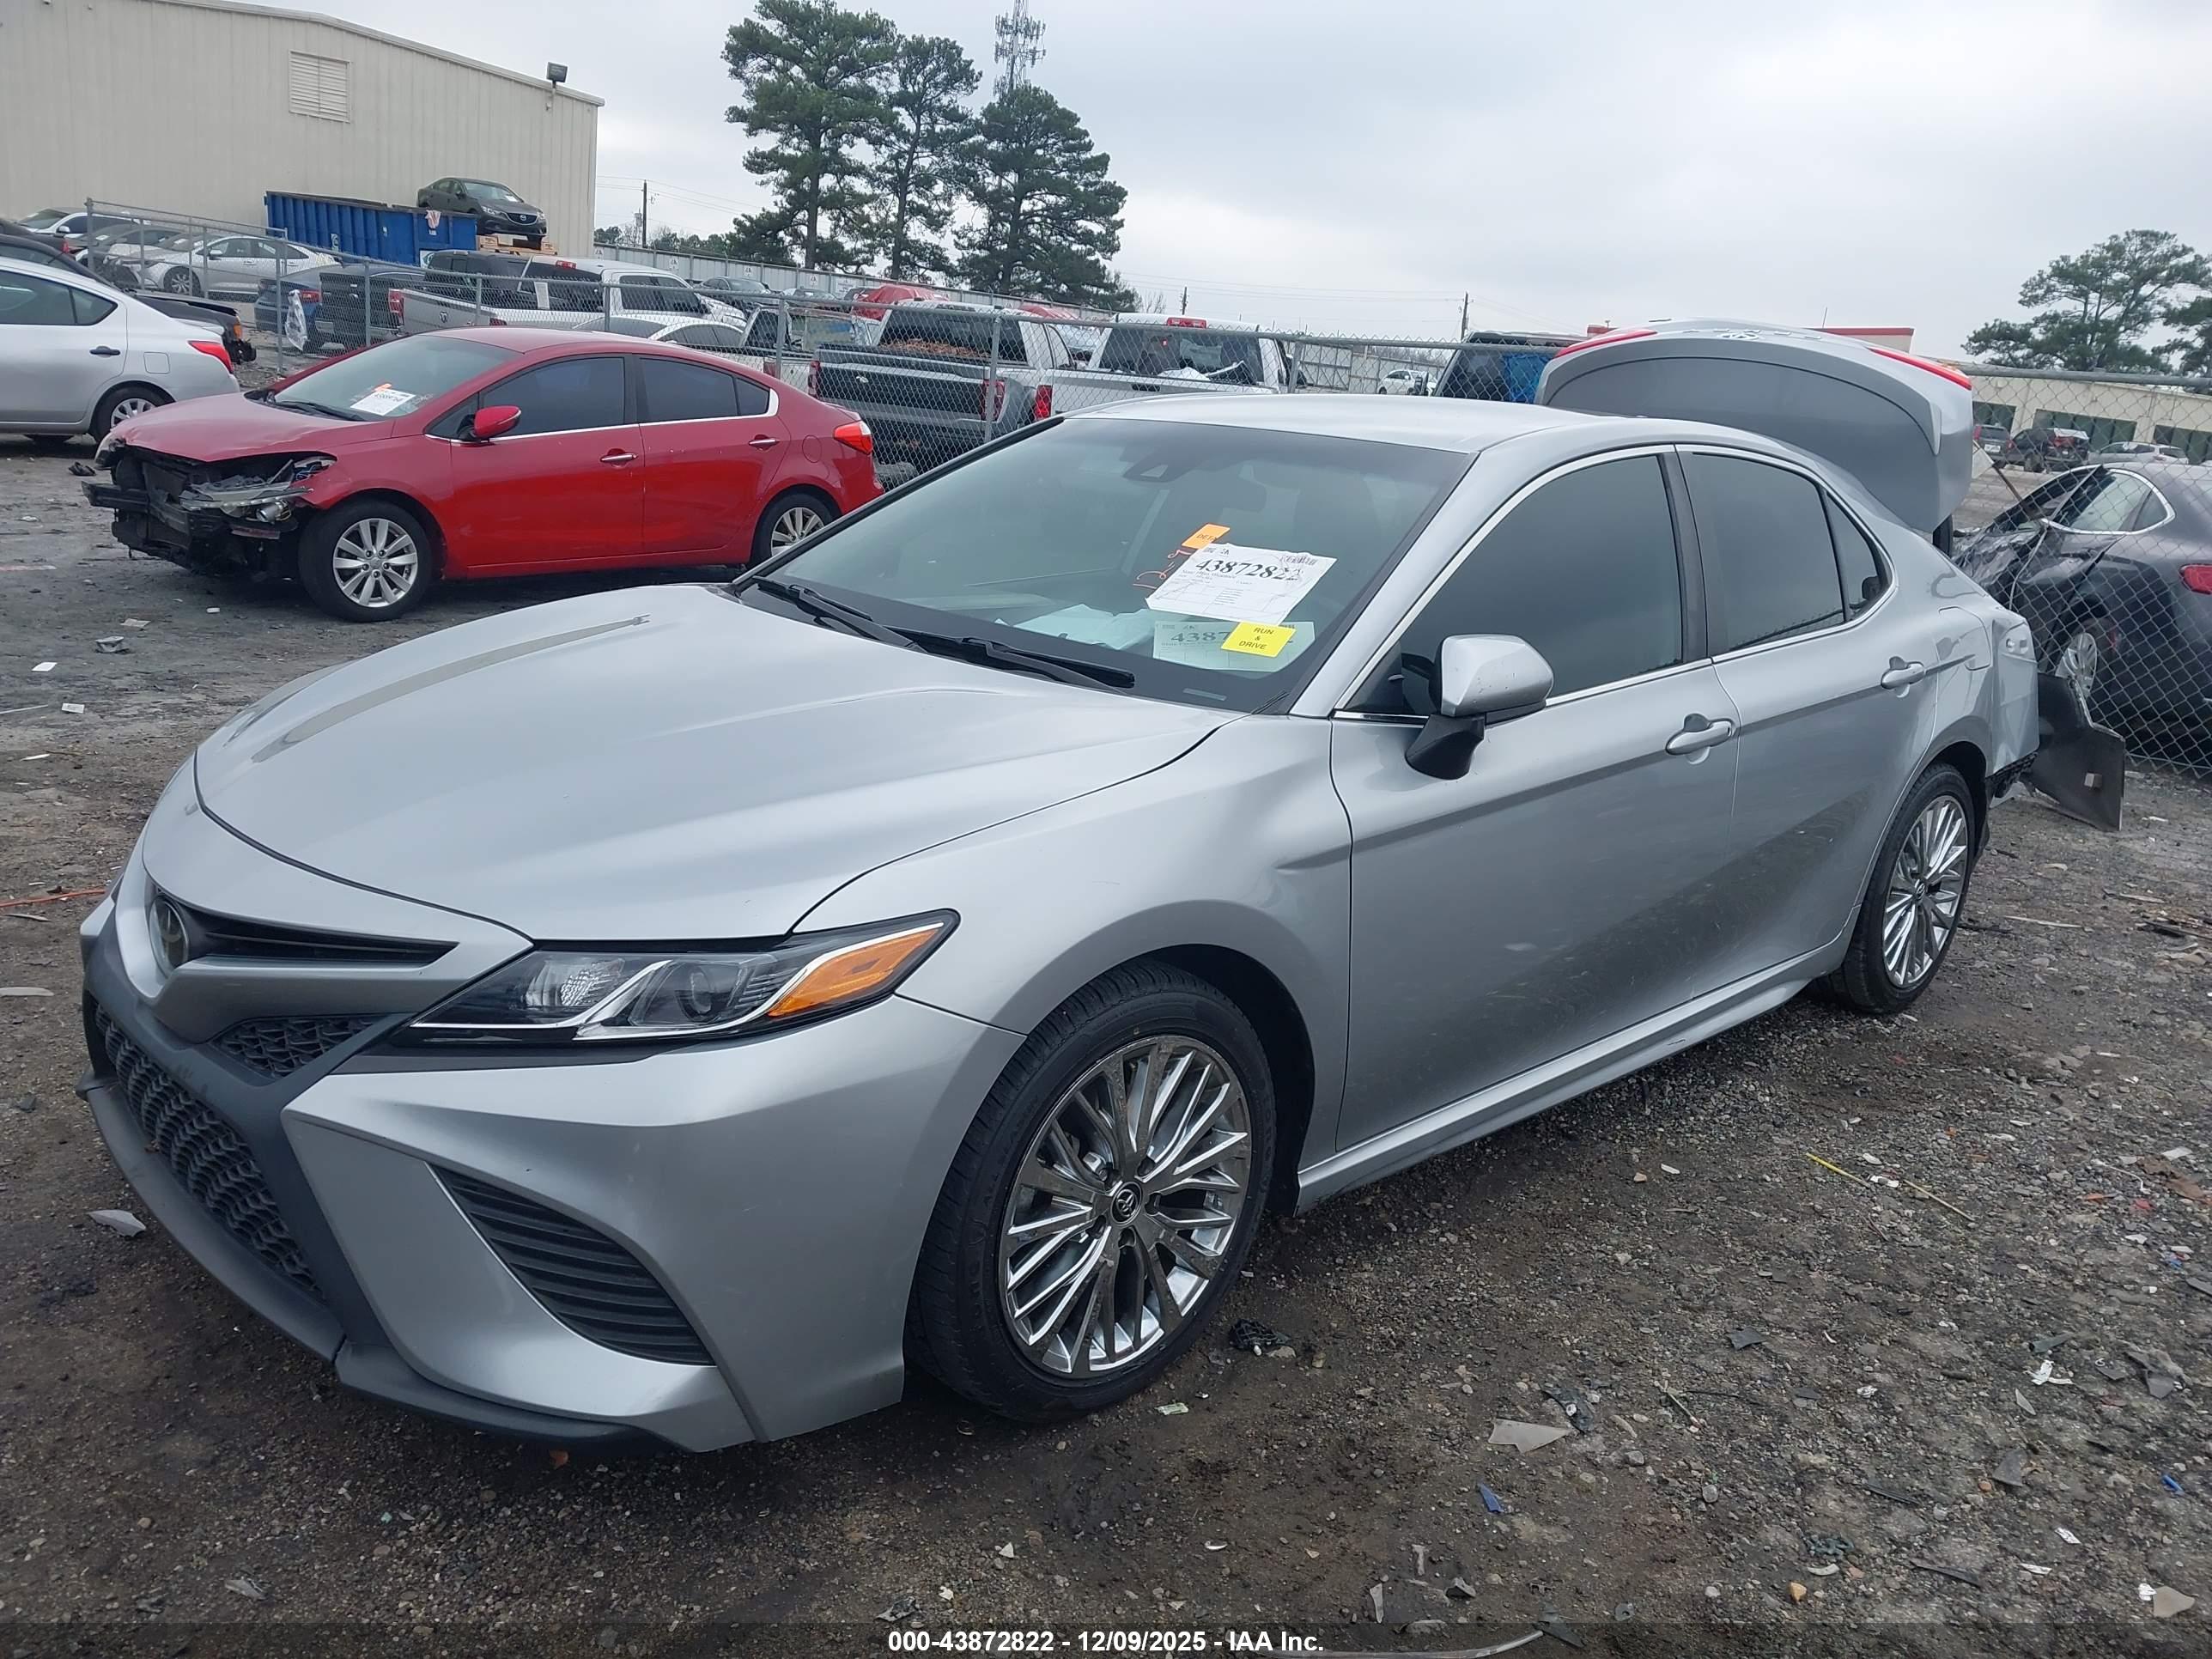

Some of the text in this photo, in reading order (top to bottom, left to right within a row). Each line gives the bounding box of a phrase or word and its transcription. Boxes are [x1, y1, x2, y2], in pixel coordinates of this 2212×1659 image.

[1195, 559, 1299, 581] 43872822
[1253, 627, 1274, 635] RUN
[1170, 631, 1231, 642] 4387
[1239, 640, 1267, 650] DRIVE
